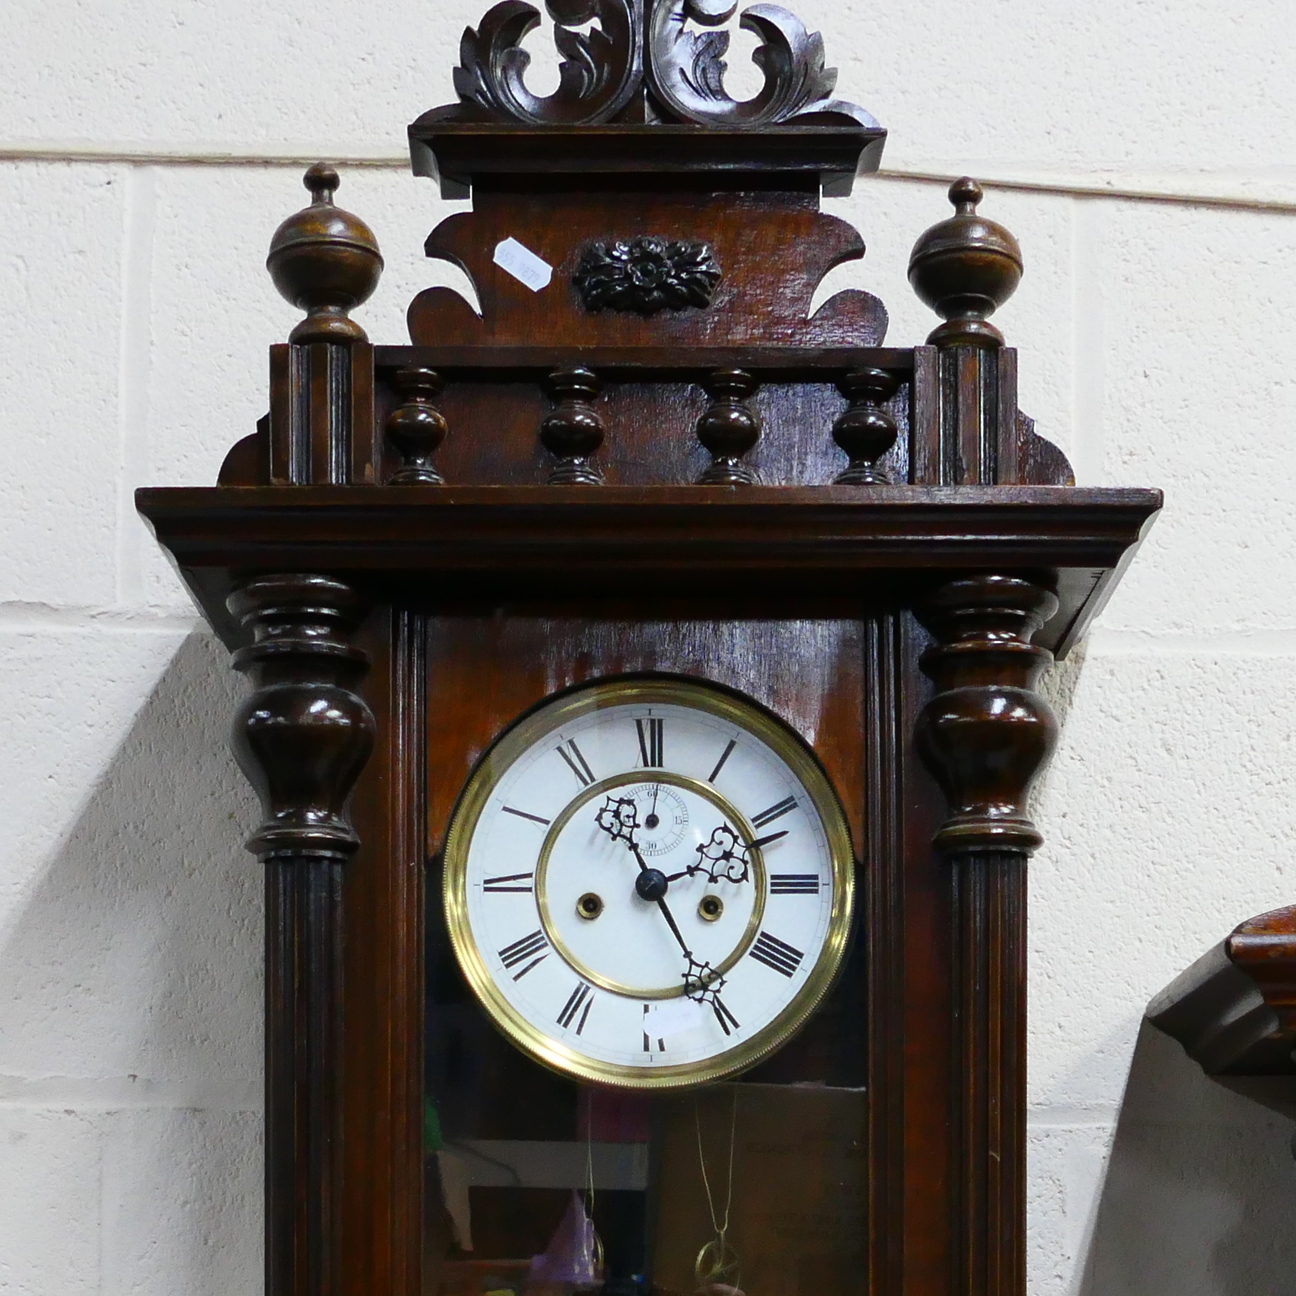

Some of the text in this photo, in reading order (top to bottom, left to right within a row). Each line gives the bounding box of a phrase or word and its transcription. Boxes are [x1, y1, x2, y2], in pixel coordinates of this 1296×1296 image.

[555, 738, 597, 787] XI
[634, 718, 664, 768] XII
[708, 740, 736, 783] I
[497, 799, 551, 834] X
[750, 795, 799, 829] II
[770, 873, 820, 895] III
[497, 928, 550, 982] VIII
[556, 980, 596, 1036] VII
